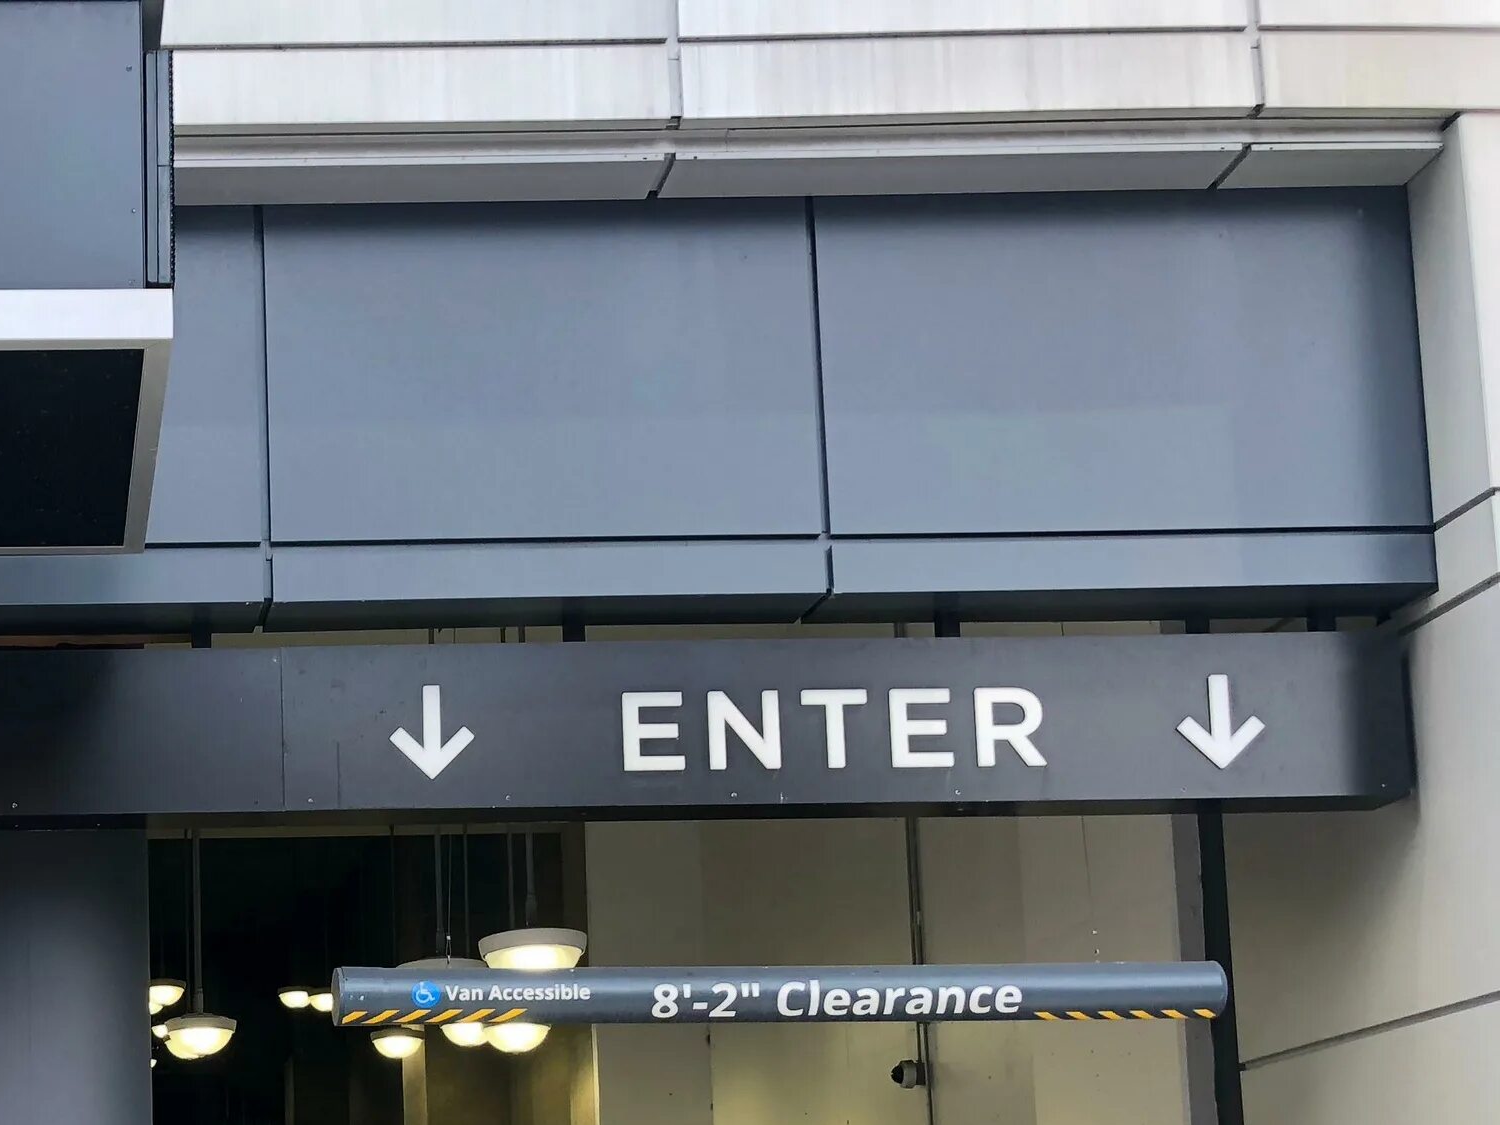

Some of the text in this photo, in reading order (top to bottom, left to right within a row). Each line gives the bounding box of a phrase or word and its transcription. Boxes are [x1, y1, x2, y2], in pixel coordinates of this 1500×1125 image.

[621, 687, 1048, 772] ENTER
[444, 982, 591, 1002] Van Accessible
[651, 979, 1024, 1018] 8'-2" Clearance
